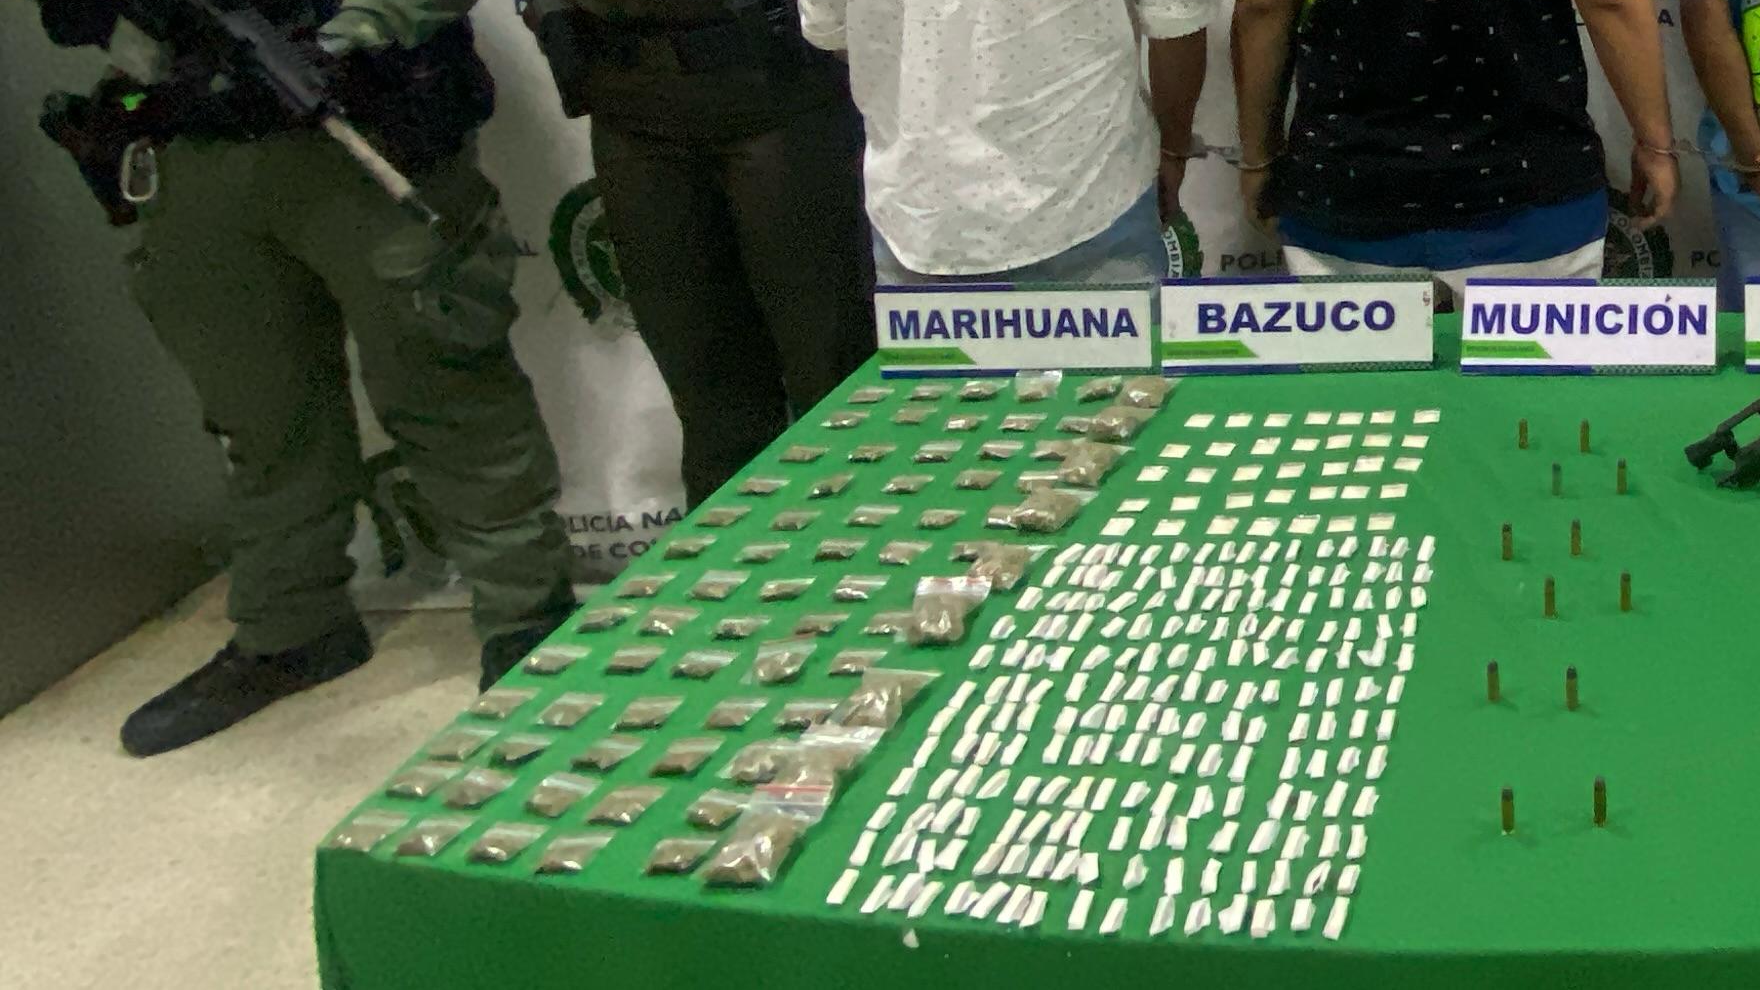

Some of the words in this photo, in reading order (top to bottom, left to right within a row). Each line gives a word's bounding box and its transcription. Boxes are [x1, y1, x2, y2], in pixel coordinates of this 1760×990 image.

[889, 307, 1138, 340] MARIHUANA
[1197, 300, 1396, 334] BAZUCO
[1470, 294, 1709, 335] MUNICIÓN
